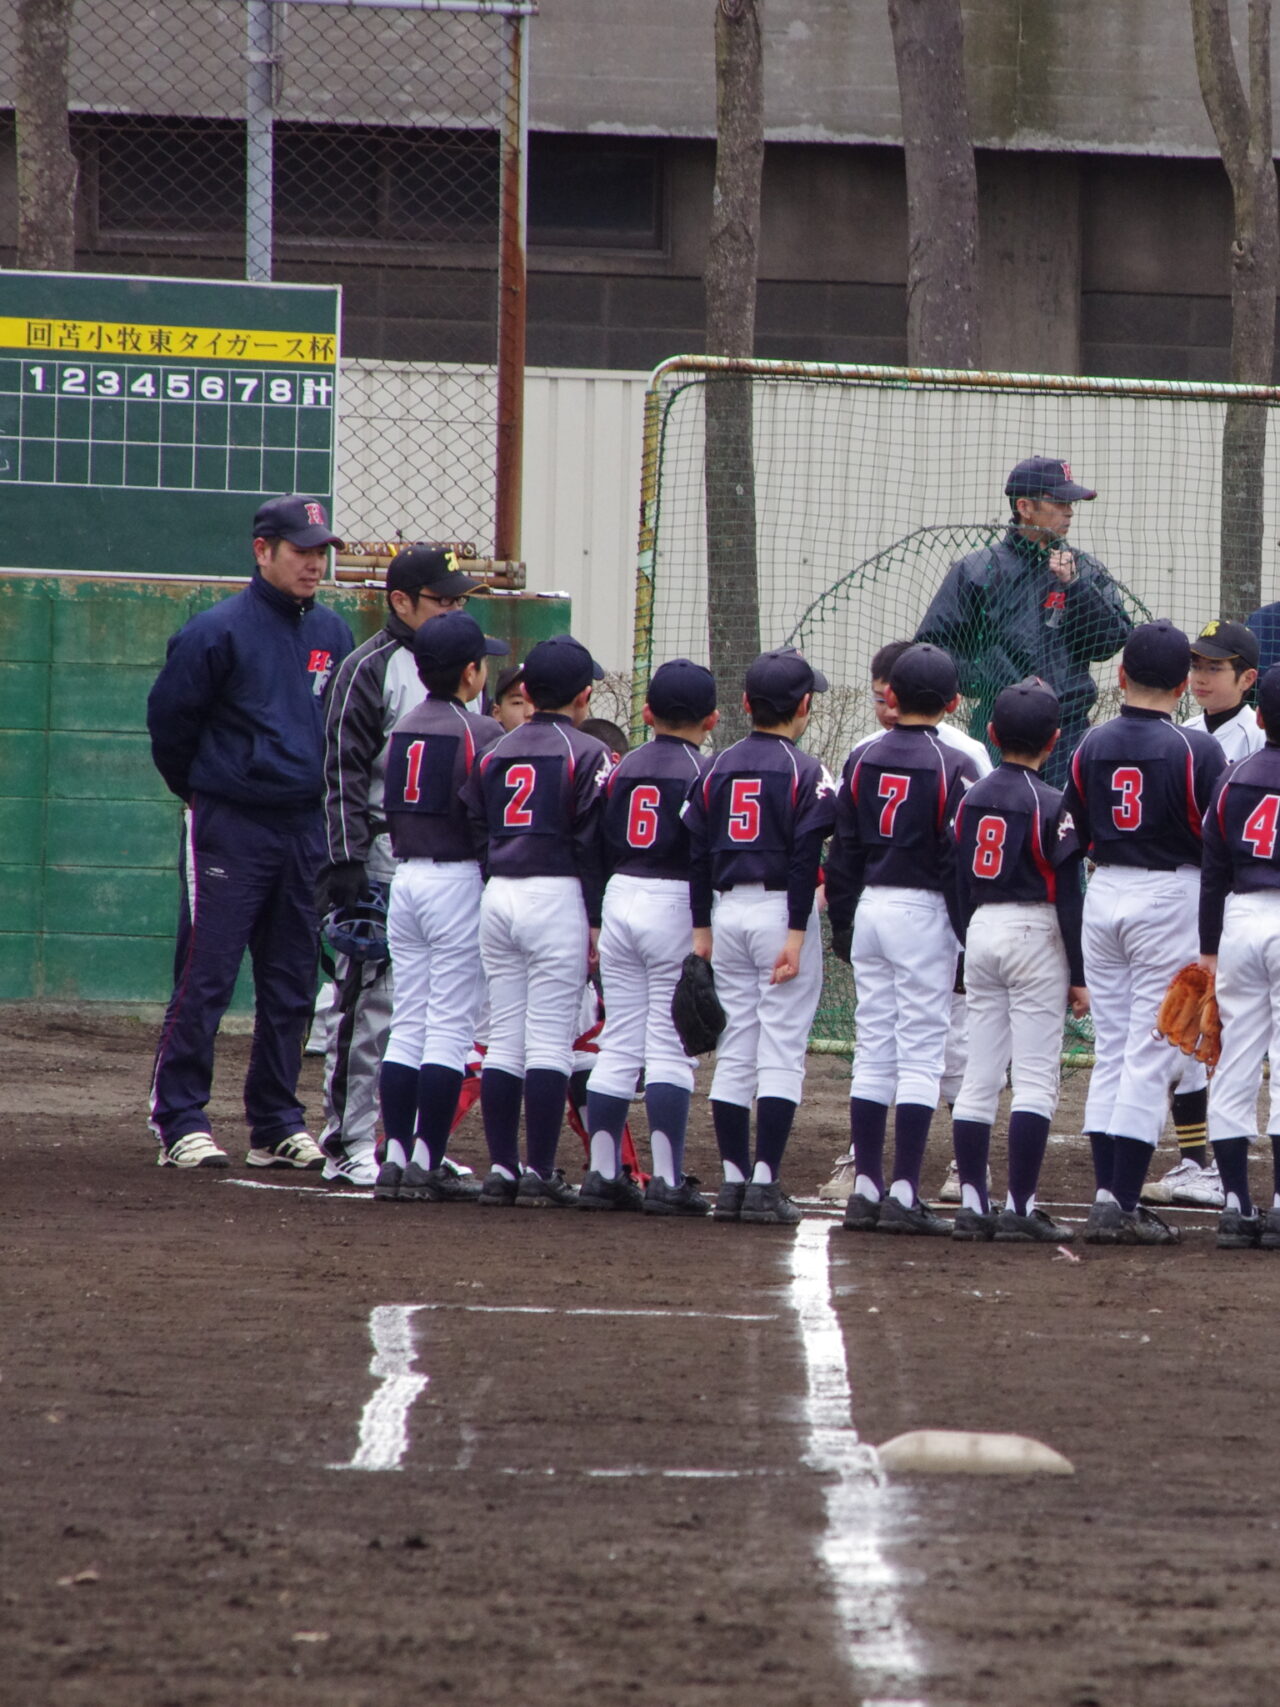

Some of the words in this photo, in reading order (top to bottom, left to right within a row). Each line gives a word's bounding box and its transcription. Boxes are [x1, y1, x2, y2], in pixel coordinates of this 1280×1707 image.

[26, 320, 335, 362] 回苫小牧東タイガース杯
[29, 366, 44, 392] 1
[61, 367, 86, 393] 2
[96, 370, 120, 395] 3
[130, 372, 155, 397] 4
[166, 374, 190, 399] 5
[200, 376, 225, 400] 6
[234, 377, 259, 402] 7
[269, 378, 292, 402] 8
[302, 377, 333, 405] 計
[403, 740, 425, 804] 1
[503, 763, 537, 827] 2
[1111, 766, 1144, 832] 3
[626, 784, 660, 849] 6
[727, 778, 762, 843] 5
[877, 772, 911, 838] 7
[972, 815, 1007, 879] 8
